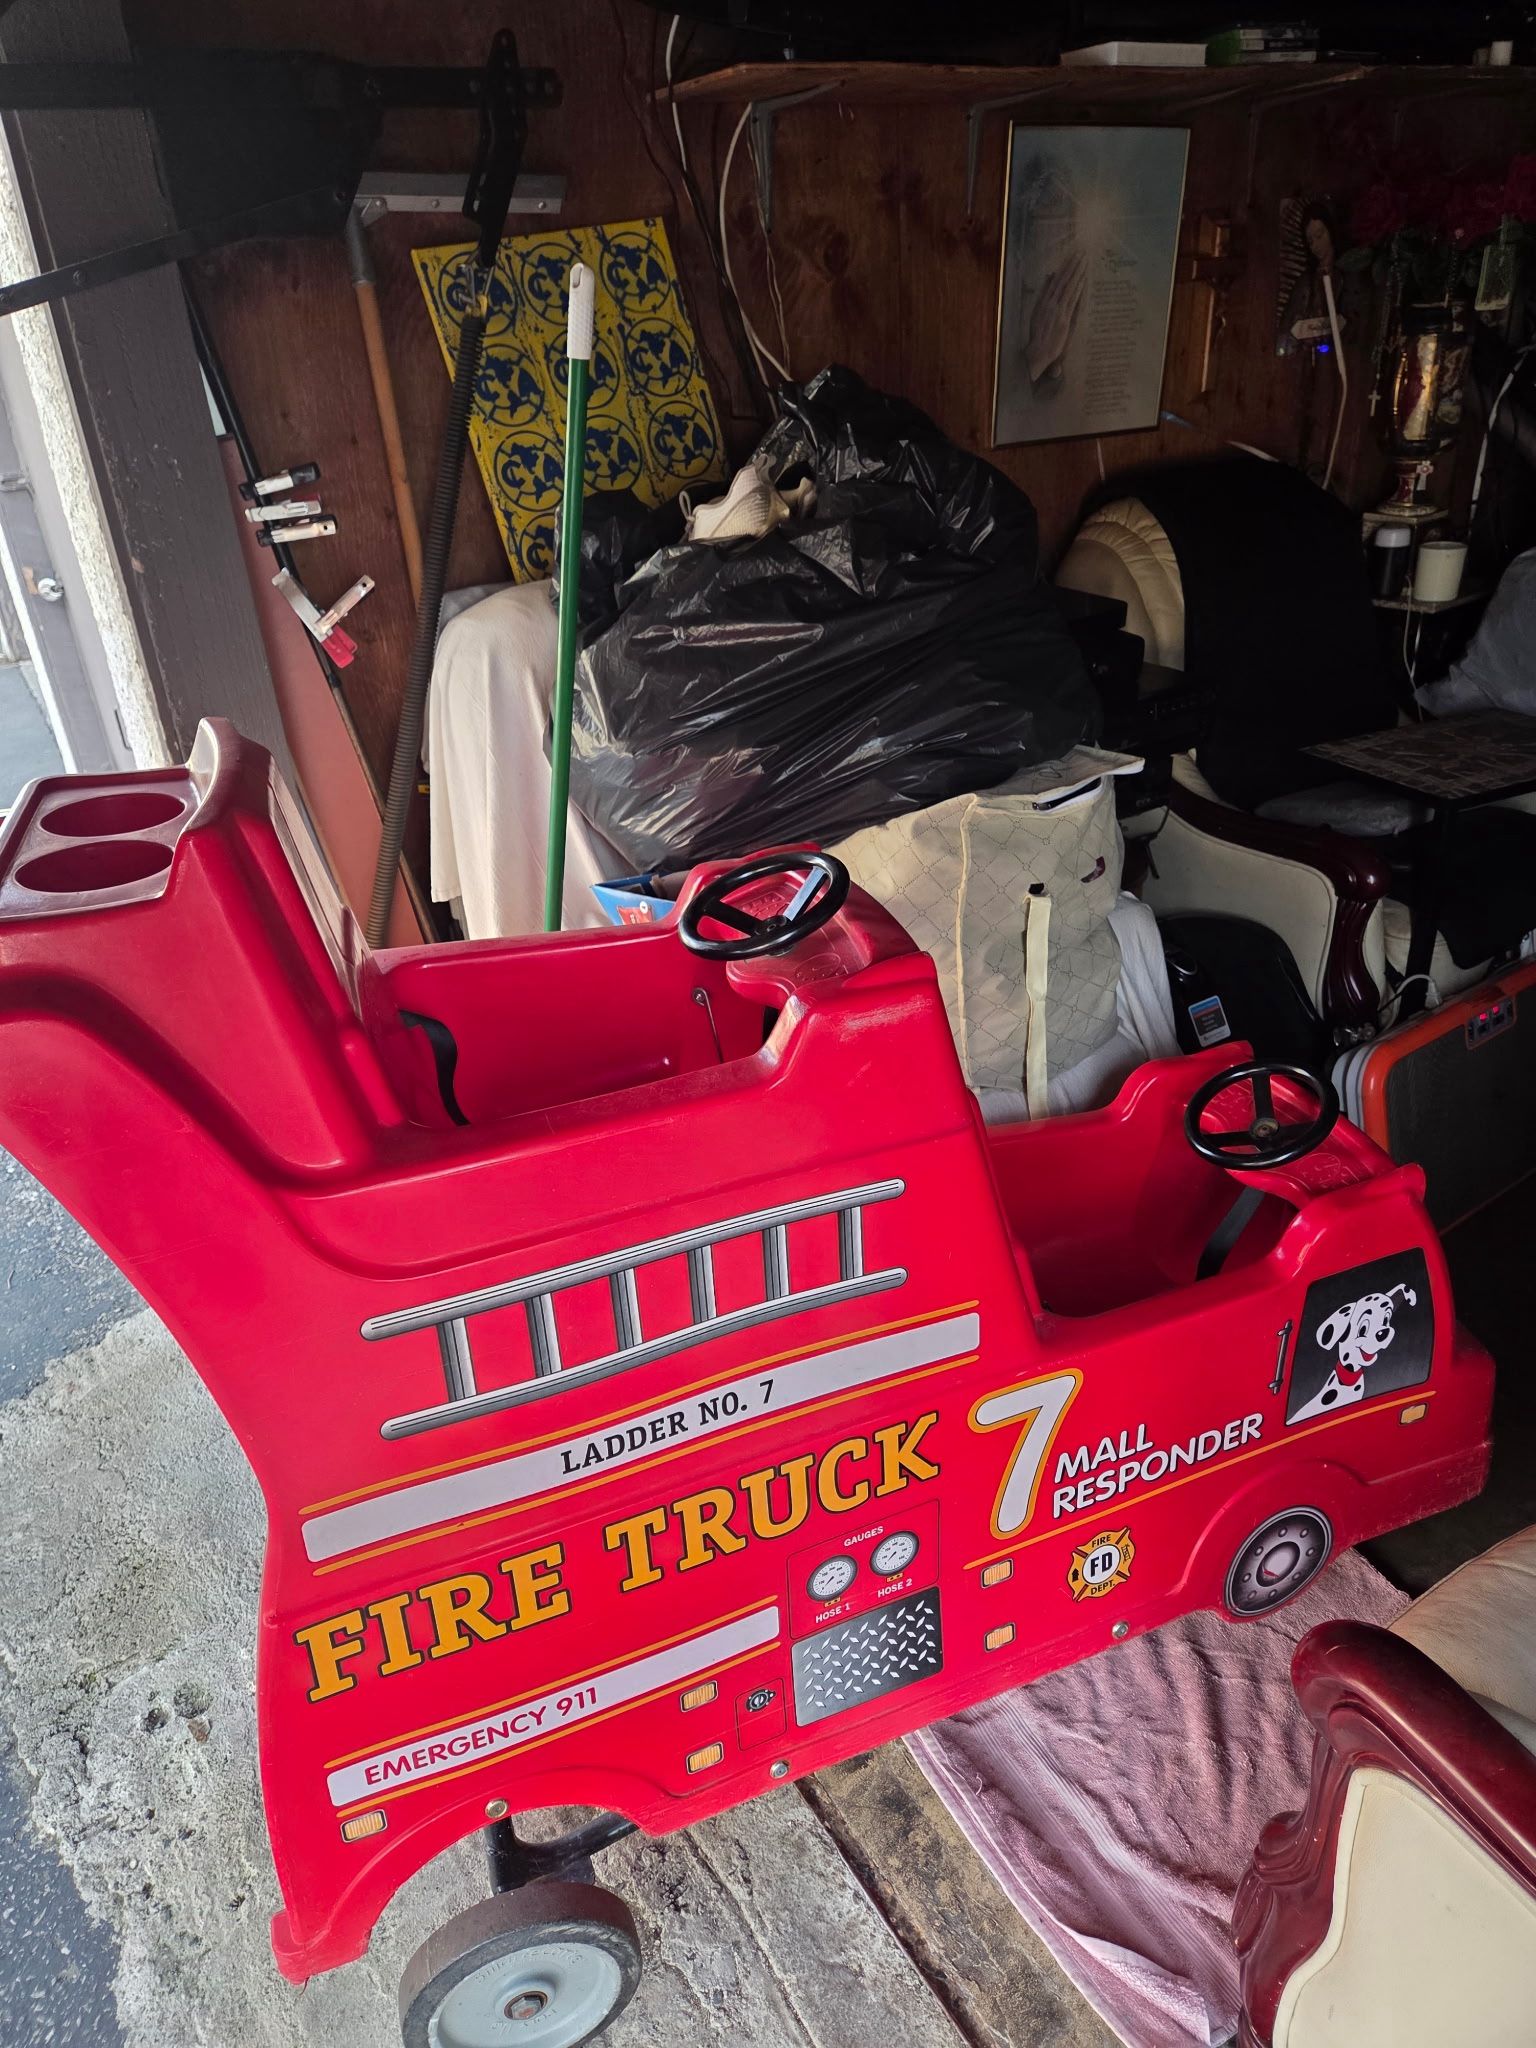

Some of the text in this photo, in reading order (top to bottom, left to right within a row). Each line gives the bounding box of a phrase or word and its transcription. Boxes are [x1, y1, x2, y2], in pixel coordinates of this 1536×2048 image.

[560, 1378, 774, 1475] LADDER NO. 7
[967, 1367, 1084, 1540] 7
[1052, 1413, 1265, 1519] RESPONDER
[1054, 1424, 1154, 1484] MALL
[291, 1409, 941, 1704] FIRE TRUCK
[843, 1525, 885, 1548] GAUGES
[1091, 1533, 1112, 1548] FIRE
[1090, 1551, 1113, 1578] FD
[877, 1578, 913, 1598] HOSE 2
[1090, 1579, 1116, 1596] DEPT.
[815, 1603, 851, 1624] HOSE 1
[364, 1687, 598, 1786] EMERGENCY 911
